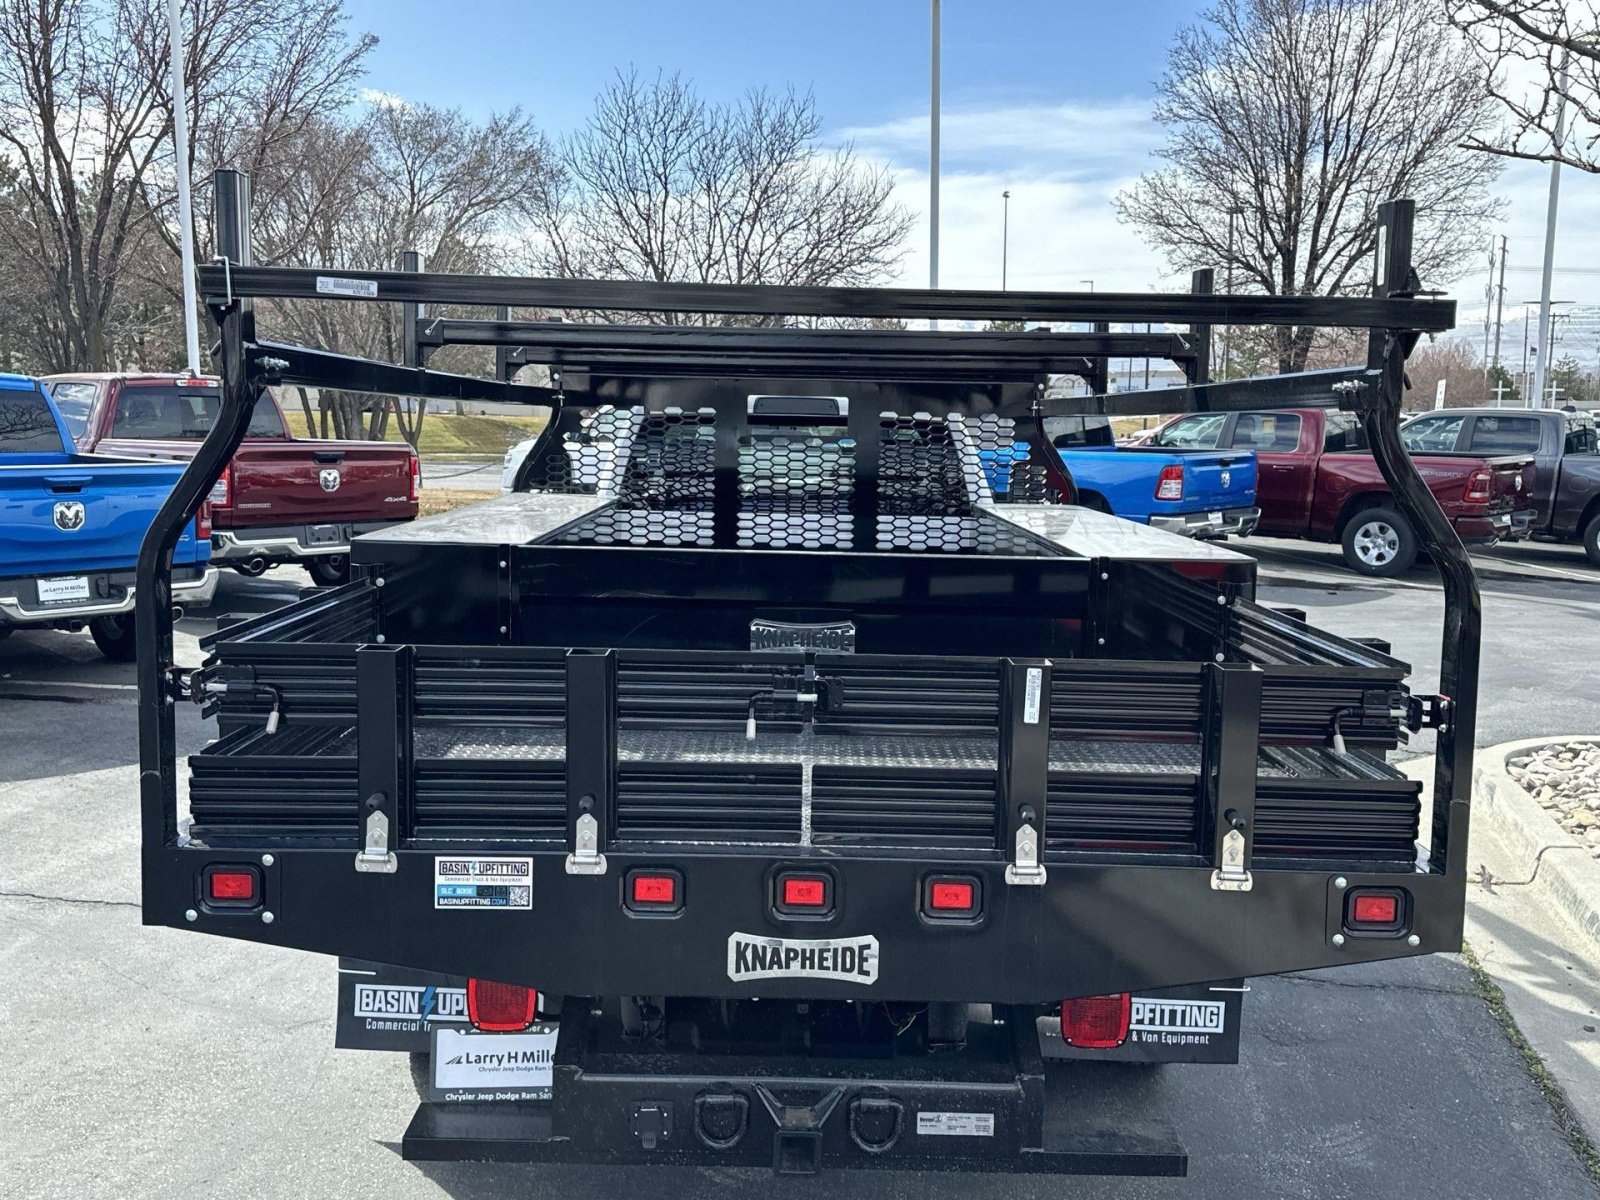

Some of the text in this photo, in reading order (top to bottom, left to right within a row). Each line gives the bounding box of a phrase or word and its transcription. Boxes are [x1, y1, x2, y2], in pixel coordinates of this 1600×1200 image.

[441, 863, 527, 875] BASIN UPFITTING
[735, 940, 871, 977] KNAPHEIDE
[361, 989, 419, 1014] BASIN
[1131, 1003, 1219, 1027] PFITTING
[366, 1018, 420, 1032] Commercial
[1132, 1030, 1209, 1045] & Van Equipment
[465, 1052, 505, 1066] Larry
[507, 1051, 518, 1063] H
[445, 1093, 475, 1101] Chrysler
[477, 1093, 494, 1101] Jeep
[495, 1092, 519, 1101] Dodge
